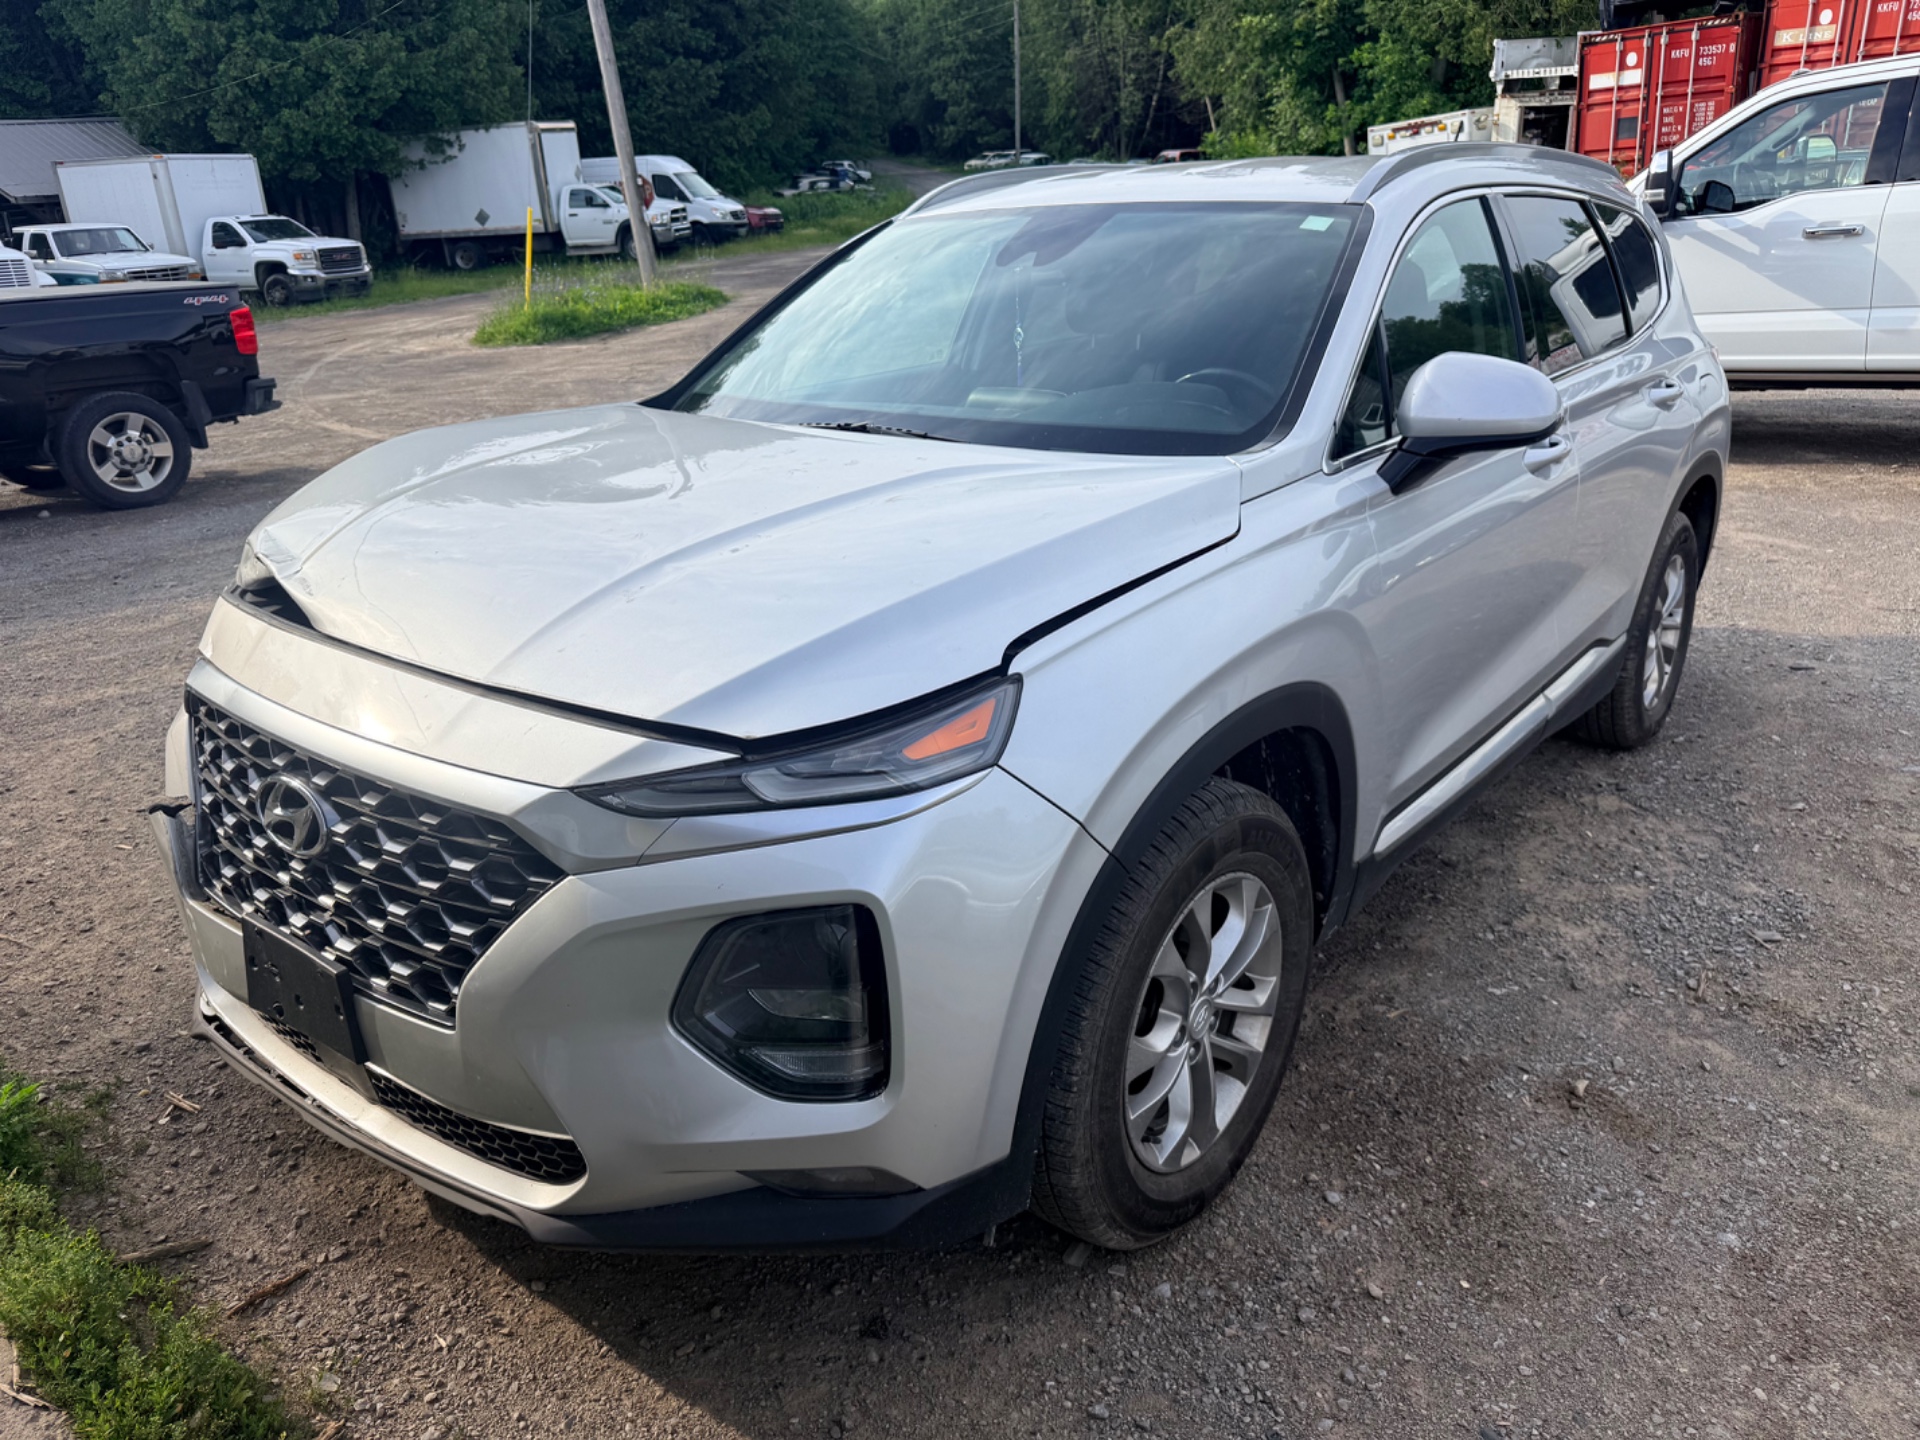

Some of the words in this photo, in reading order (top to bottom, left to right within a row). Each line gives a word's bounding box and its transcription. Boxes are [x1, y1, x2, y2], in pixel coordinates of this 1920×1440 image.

[1877, 1, 1900, 13] KKFU
[1781, 31, 1795, 43] K
[1799, 29, 1833, 41] LINE
[1671, 48, 1690, 59] KKFU
